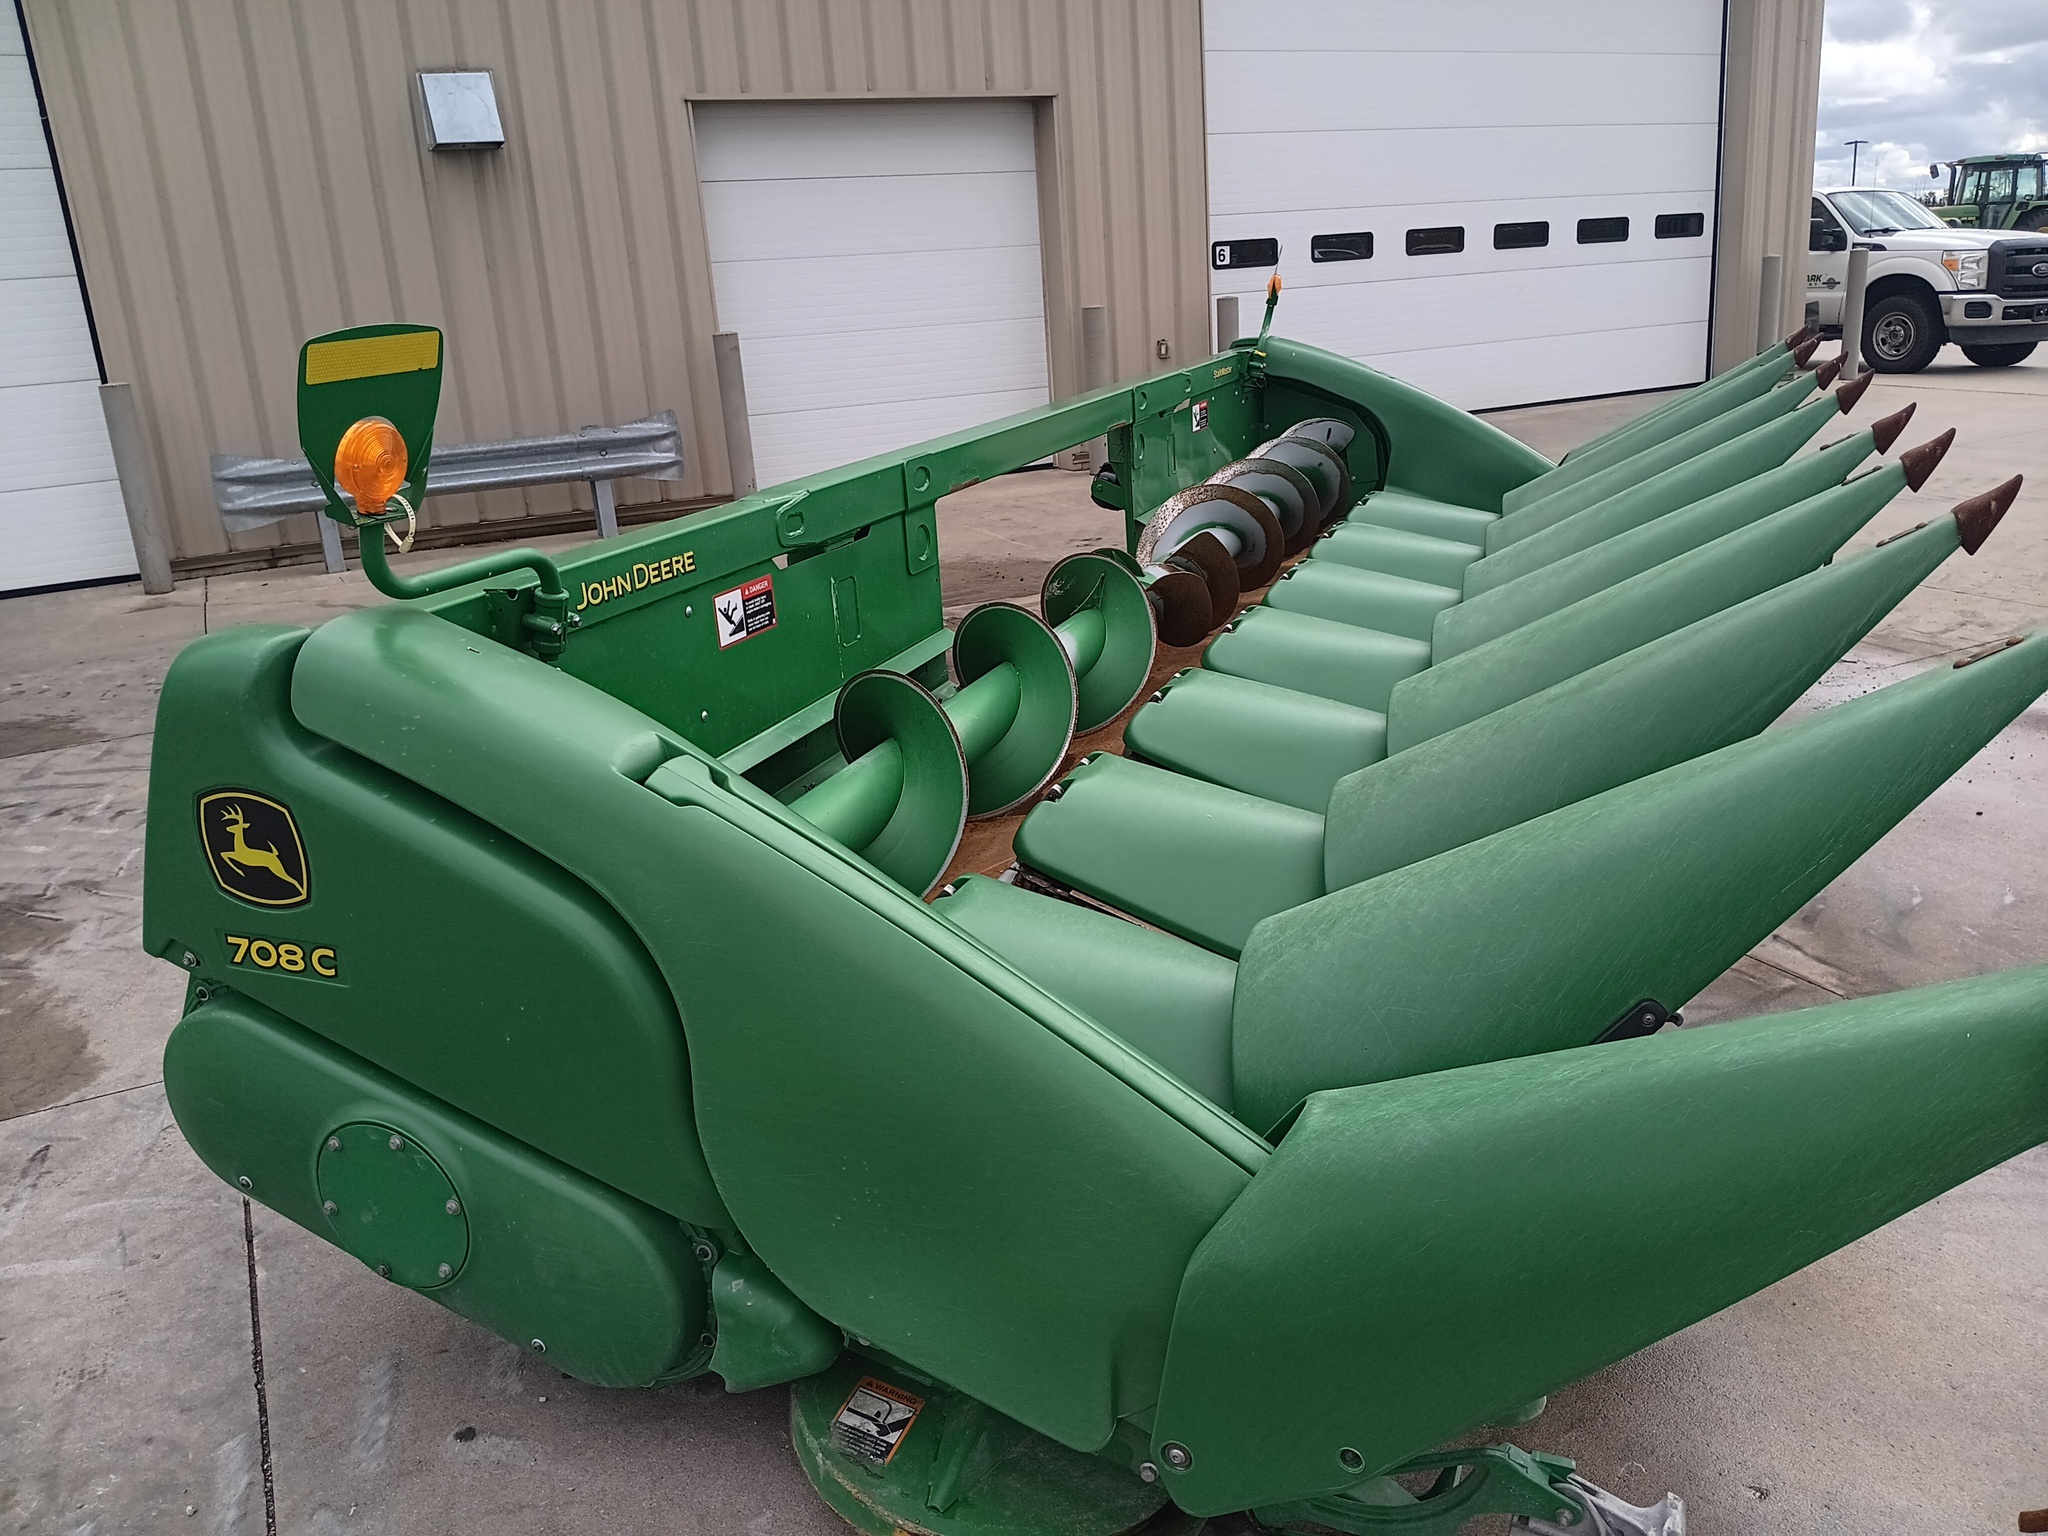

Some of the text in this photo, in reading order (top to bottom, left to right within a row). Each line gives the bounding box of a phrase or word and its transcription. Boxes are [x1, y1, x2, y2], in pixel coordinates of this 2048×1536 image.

[1218, 248, 1226, 262] 6
[576, 550, 697, 611] JOHN DEERE
[749, 580, 769, 594] DANGER
[226, 935, 306, 972] 708
[875, 1383, 918, 1406] WARNING
